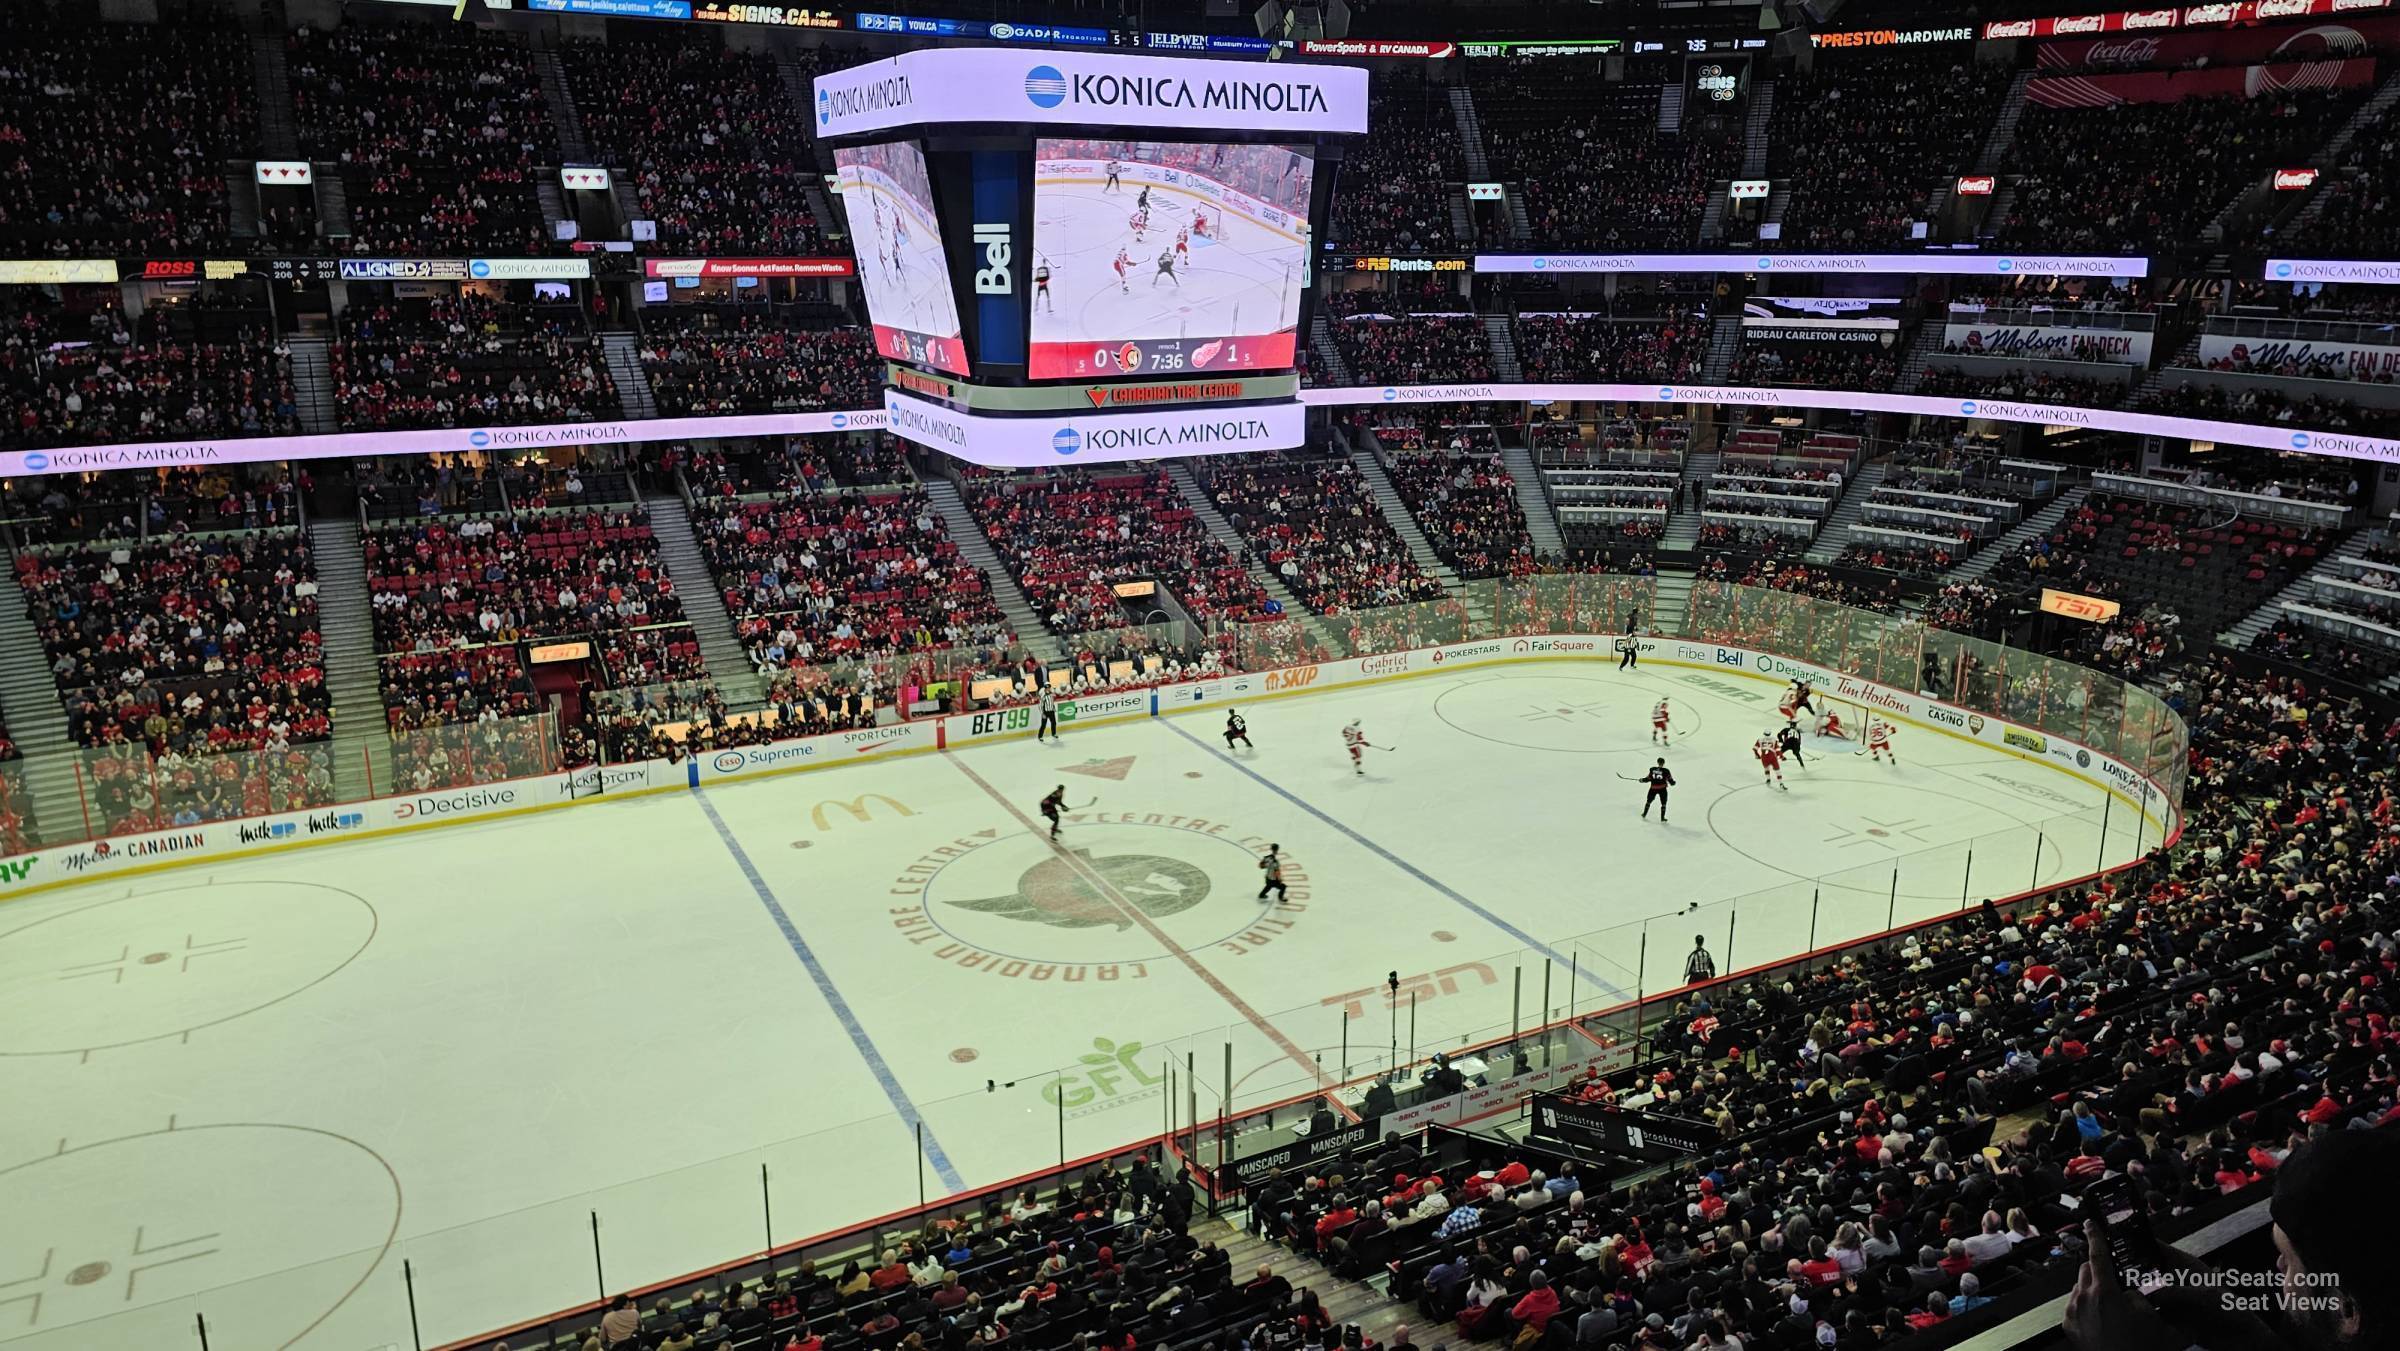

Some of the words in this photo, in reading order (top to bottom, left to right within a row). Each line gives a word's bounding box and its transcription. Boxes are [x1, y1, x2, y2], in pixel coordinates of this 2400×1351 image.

[728, 4, 811, 26] SIGNS.CA
[908, 20, 937, 32] YOW.CA
[1014, 28, 1061, 39] GADAR
[1114, 34, 1120, 45] 5
[1134, 36, 1140, 46] 5
[1686, 39, 1706, 52] 7:35
[1821, 30, 1897, 47] PRESTON
[1896, 28, 1973, 44] HARDWARE
[1305, 41, 1367, 55] PowerSports
[1369, 44, 1377, 53] &
[1379, 43, 1391, 54] RV
[1392, 43, 1429, 54] CANADA
[1634, 41, 1642, 53] 0
[2085, 37, 2163, 64] Coca-Cola
[1698, 64, 1722, 77] GO
[1697, 76, 1736, 90] SENS
[829, 87, 867, 118] KONICA
[867, 75, 913, 112] MINOLTA
[1074, 74, 1196, 108] KONICA
[1203, 80, 1329, 112] MINOLTA
[1711, 88, 1735, 101] GO
[316, 261, 334, 269] 307
[973, 223, 1012, 294] Bell
[1548, 259, 1588, 269] KONICA
[1590, 259, 1635, 269] MINOLTA
[1772, 259, 1815, 269] KONICA
[1817, 259, 1866, 269] MINOLTA
[2014, 260, 2061, 271] KONICA
[2064, 261, 2116, 272] MINOLTA
[143, 260, 196, 275] ROSS
[274, 271, 293, 279] 206
[318, 271, 336, 279] 207
[342, 261, 417, 277] ALIGNED
[493, 264, 538, 274] KONICA
[540, 264, 588, 274] MINOLTA
[711, 264, 731, 272] Know
[2294, 265, 2346, 277] KONICA
[1746, 329, 1784, 340] RIDEAU
[1786, 330, 1837, 342] CARLETON
[1838, 331, 1877, 342] CASINO
[1984, 328, 2068, 350] Molson
[2098, 336, 2132, 356] DECK
[1094, 349, 1107, 368] 0
[1151, 353, 1184, 370] 7:36
[1227, 344, 1238, 362] 1
[2250, 342, 2345, 367] Molson
[2349, 351, 2378, 374] FAN
[1111, 386, 1174, 402] CANADIAN
[1398, 389, 1442, 403] KONICA
[1444, 388, 1493, 401] MINOLTA
[1675, 389, 1722, 400] KONICA
[1726, 390, 1780, 402] MINOLTA
[1979, 403, 2029, 418] KONICA
[2032, 408, 2090, 424] MINOLTA
[493, 430, 557, 444] KONICA
[560, 427, 628, 439] MINOLTA
[900, 408, 931, 435] KONICA
[930, 420, 967, 447] MINOLTA
[1087, 427, 1173, 449] KONICA
[1178, 420, 1269, 443] MINOLTA
[2313, 437, 2377, 457] KONICA
[53, 451, 131, 467] KONICA
[136, 447, 219, 461] MINOLTA
[2055, 595, 2105, 619] TSN
[1444, 645, 1501, 659] POKERSTARS
[1532, 640, 1595, 653] FairSquare
[1361, 653, 1409, 674] Gabriel
[1677, 646, 1706, 661] Fibe
[1717, 648, 1744, 667] Bell
[1279, 665, 1319, 689] SKIP
[1376, 666, 1409, 675] PIZZA
[1776, 661, 1831, 686] Desjardins
[1836, 676, 1859, 696] Tim
[1860, 684, 1911, 715] Hortons
[1062, 697, 1142, 717] enterprise
[971, 708, 1031, 735] BET99
[1928, 709, 1964, 727] CASINO
[719, 756, 741, 767] Esso
[749, 744, 814, 764] Supreme
[418, 790, 515, 816] Decisive
[60, 848, 121, 870] Molson
[128, 833, 205, 858] CANADIAN
[889, 838, 981, 895] CENTRE
[1096, 812, 1232, 835] CENTRE
[1219, 918, 1297, 957] TIRE
[888, 905, 943, 945] TIRE
[932, 942, 1149, 983] CANADIAN
[1320, 960, 1499, 1020] TSN
[1559, 1063, 1579, 1074] BRICK
[1588, 1055, 1608, 1066] BRICK
[1601, 1062, 1621, 1073] BRICK
[1040, 1041, 1167, 1108] GFL
[1529, 1072, 1550, 1083] BRICK
[1469, 1089, 1490, 1101] BRICK
[1500, 1081, 1520, 1092] BRICK
[1431, 1101, 1452, 1113] BRICK
[1483, 1097, 1504, 1108] BRICK
[1398, 1110, 1420, 1122] BRICK
[1555, 1111, 1606, 1130] brookstreet
[1310, 1128, 1365, 1156] MANSCAPED
[1641, 1129, 1700, 1150] brookstreet
[1236, 1151, 1292, 1177] MANSCAPED
